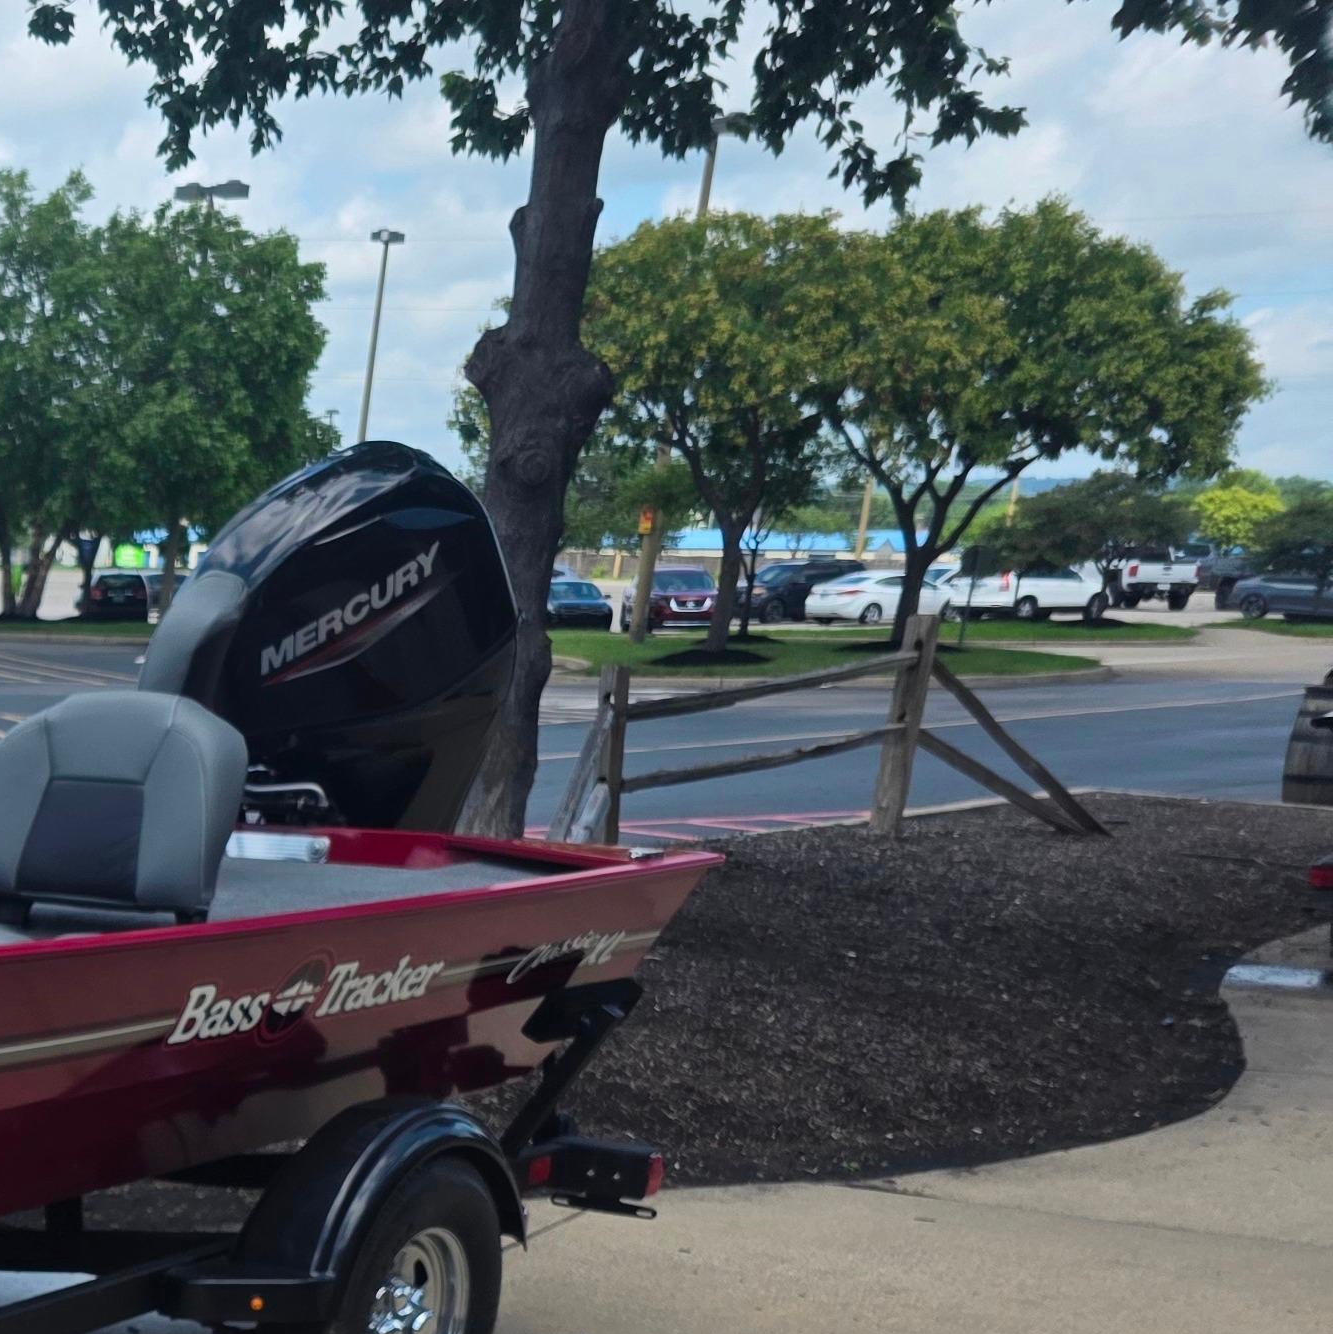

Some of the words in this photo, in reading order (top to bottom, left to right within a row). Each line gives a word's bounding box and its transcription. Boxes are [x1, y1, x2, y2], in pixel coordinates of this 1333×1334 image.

[260, 540, 440, 676] MERCURY
[167, 984, 271, 1044] Bass
[315, 955, 445, 1017] Tracker
